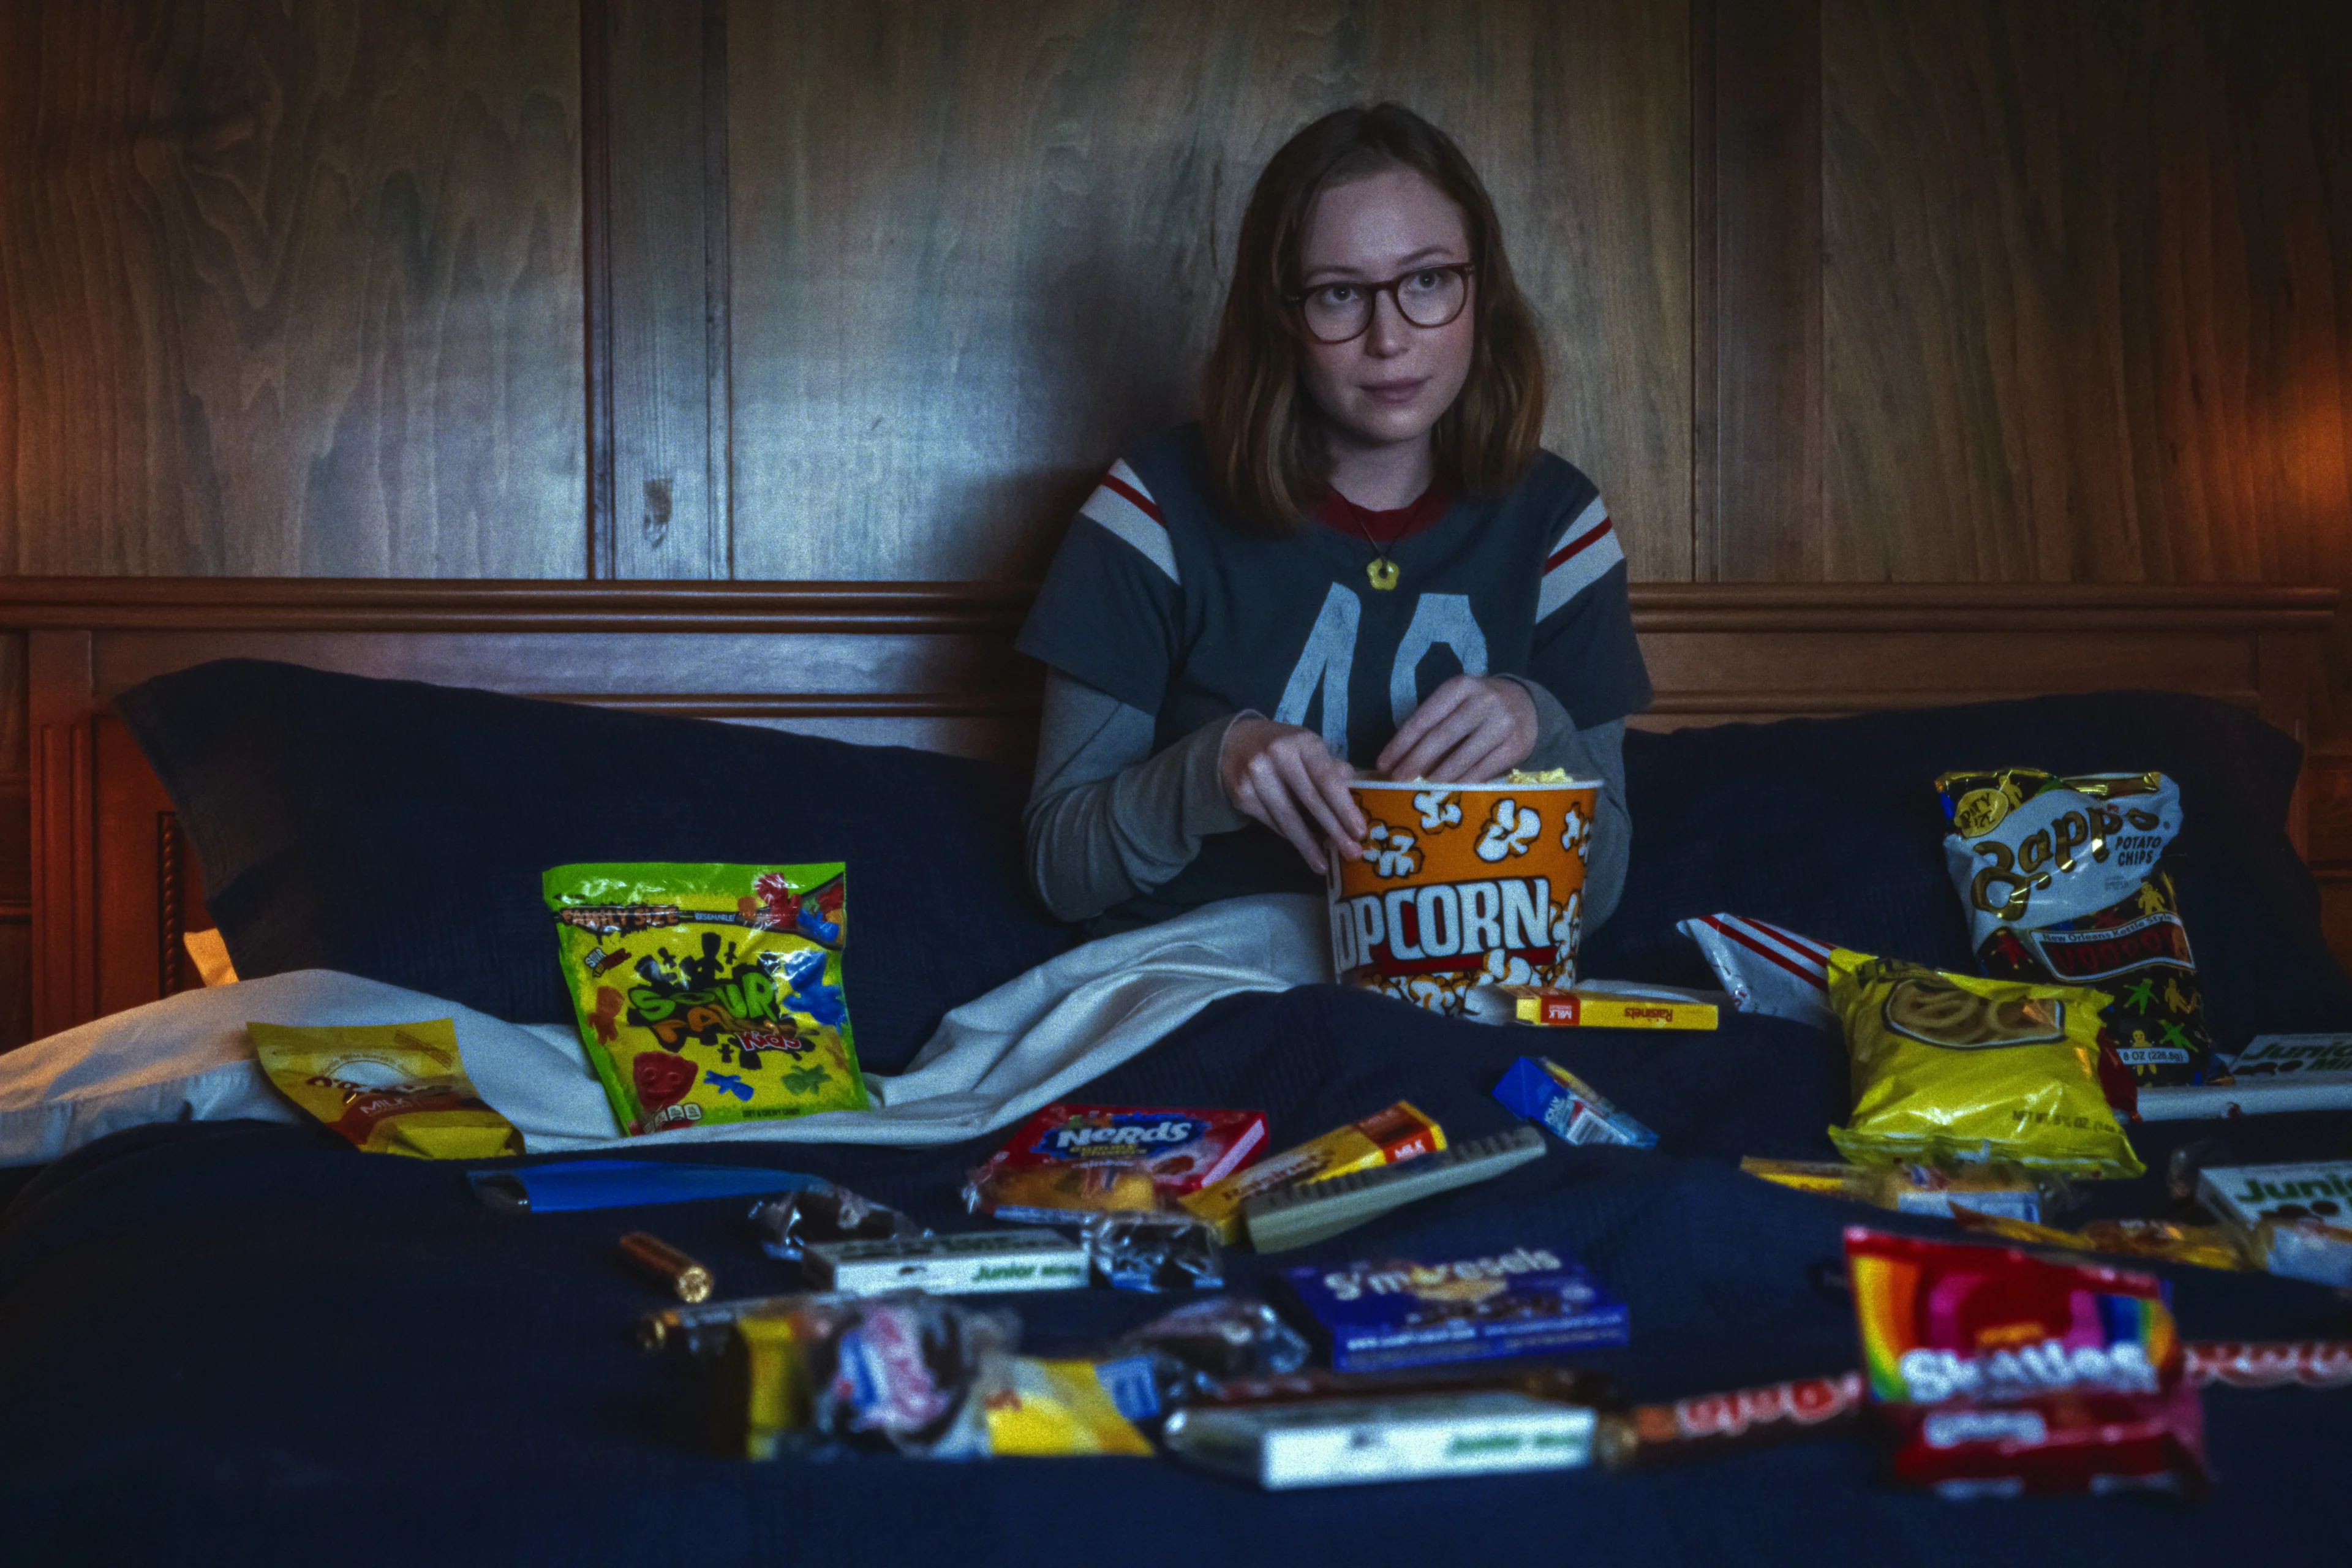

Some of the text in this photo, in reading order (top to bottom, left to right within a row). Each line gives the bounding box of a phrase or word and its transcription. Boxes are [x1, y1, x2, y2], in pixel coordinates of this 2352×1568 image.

[2115, 836, 2162, 851] POTATO
[2118, 851, 2154, 866] CHIPS
[634, 907, 679, 927] SIZE
[1334, 876, 1553, 973] OPCORN
[2043, 914, 2173, 943] New Orleans Kettle Style
[585, 948, 607, 968] SOUR
[630, 972, 777, 1022] SOUR
[1548, 1009, 1572, 1020] MILK
[1624, 1007, 1674, 1022] Raisinets
[736, 1032, 801, 1052] Kids
[2123, 1051, 2130, 1061] 8
[2132, 1051, 2146, 1060] OZ
[360, 1097, 404, 1115] MILK
[2236, 1174, 2352, 1202] Juni
